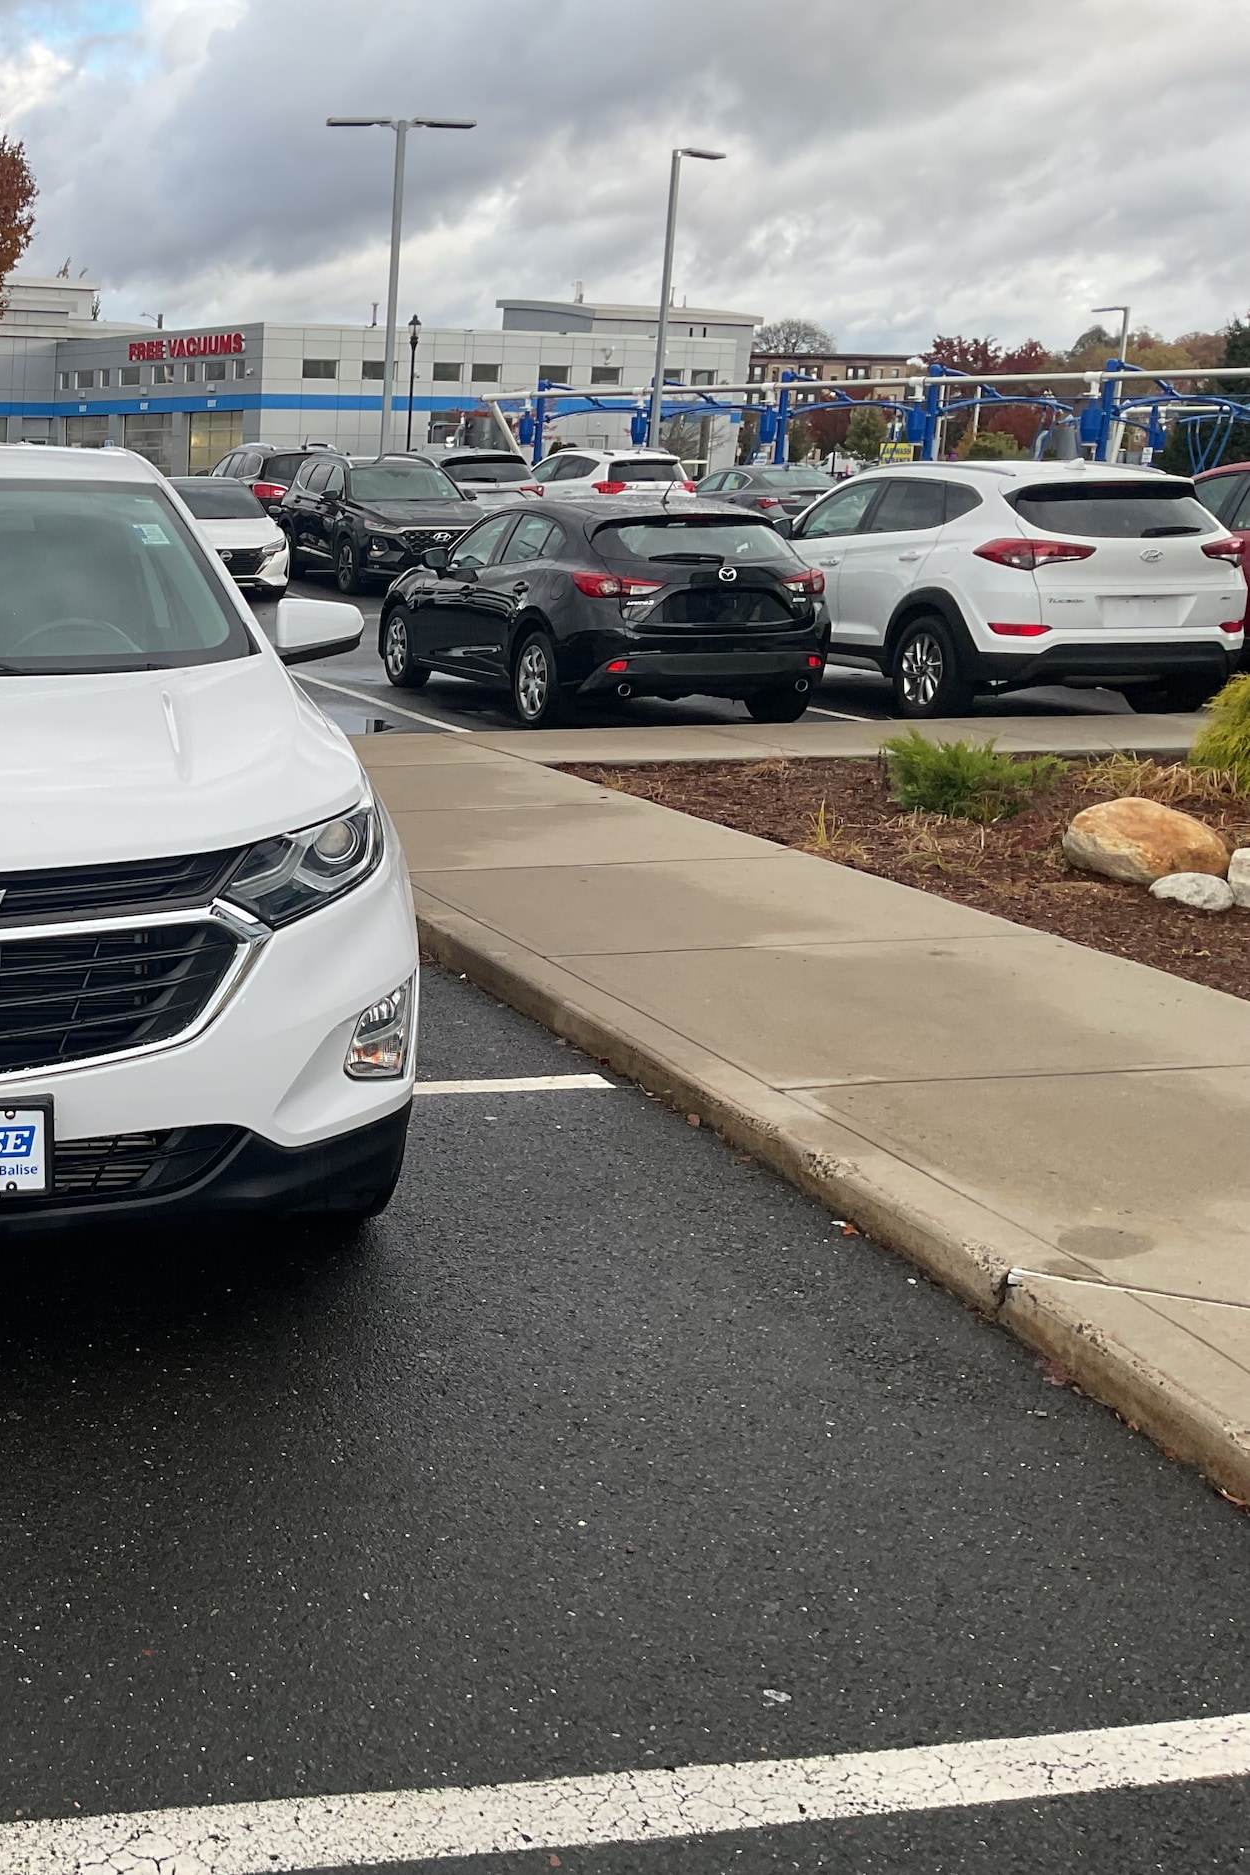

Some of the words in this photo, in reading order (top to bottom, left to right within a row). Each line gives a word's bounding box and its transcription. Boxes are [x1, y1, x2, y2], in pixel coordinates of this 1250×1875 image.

[129, 340, 165, 361] FREE
[168, 333, 245, 358] VACUUMS
[0, 1164, 38, 1176] Balise
